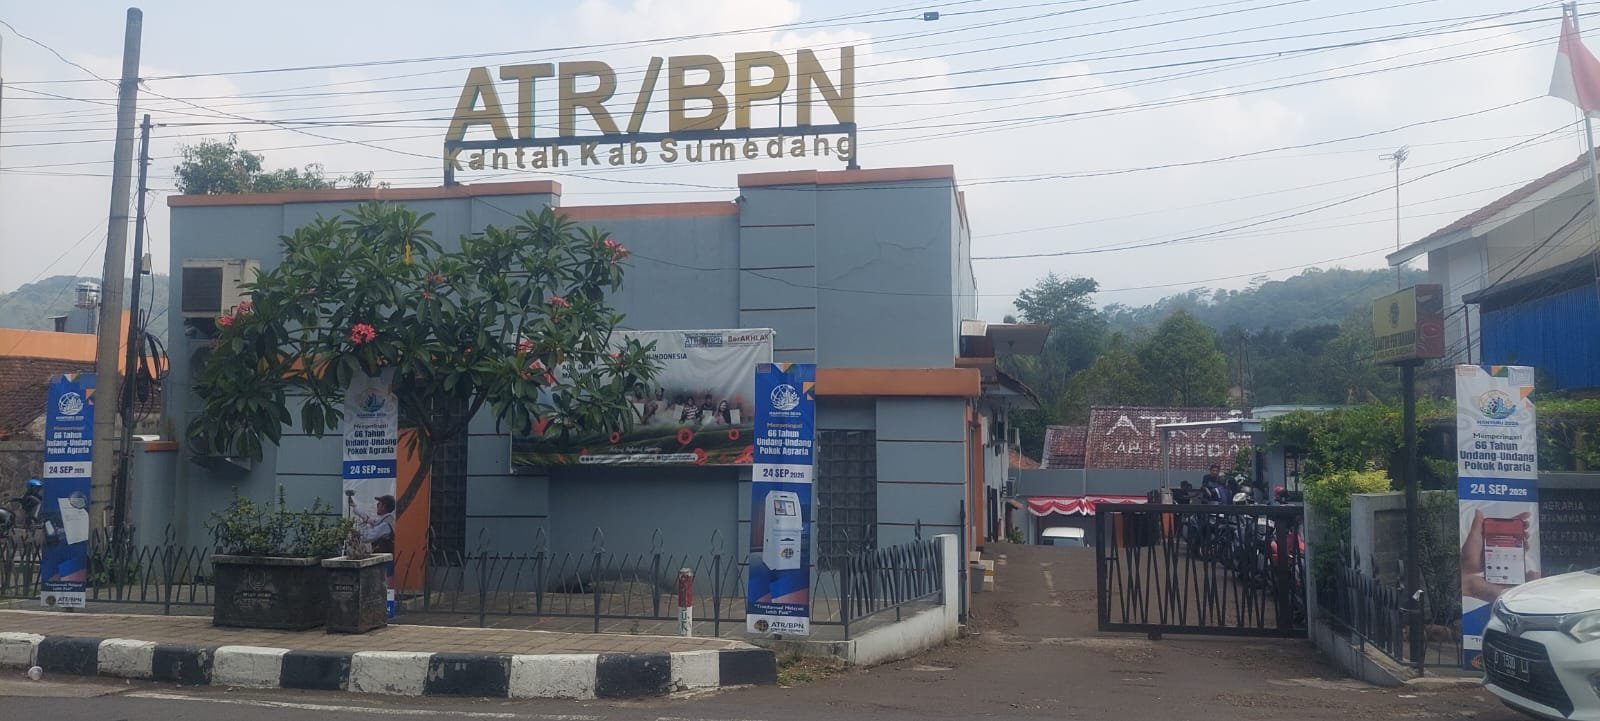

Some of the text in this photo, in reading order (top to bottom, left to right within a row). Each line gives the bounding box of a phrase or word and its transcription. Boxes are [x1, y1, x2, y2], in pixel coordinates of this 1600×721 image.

[446, 46, 855, 142] ATR/BPN
[446, 135, 855, 172] Kantah Kab Sumedang
[365, 430, 385, 438] Tahun
[778, 430, 799, 438] Tahun
[756, 438, 812, 447] Undang-Undang
[1475, 441, 1518, 451] 66 Tahun
[347, 446, 394, 455] Pokok Agraria
[760, 447, 809, 456] Pokok Agraria
[1460, 450, 1535, 462] Undang-Undang
[49, 466, 58, 474] 24
[59, 466, 73, 474] SEP
[350, 466, 361, 475] 24
[362, 465, 377, 474] SEP
[1464, 461, 1532, 472] Pokok Agraria
[763, 468, 773, 478] 24
[775, 468, 790, 478] SEP
[1470, 483, 1528, 496] 24 SEP 2026
[771, 621, 805, 629] ATR/BPN
